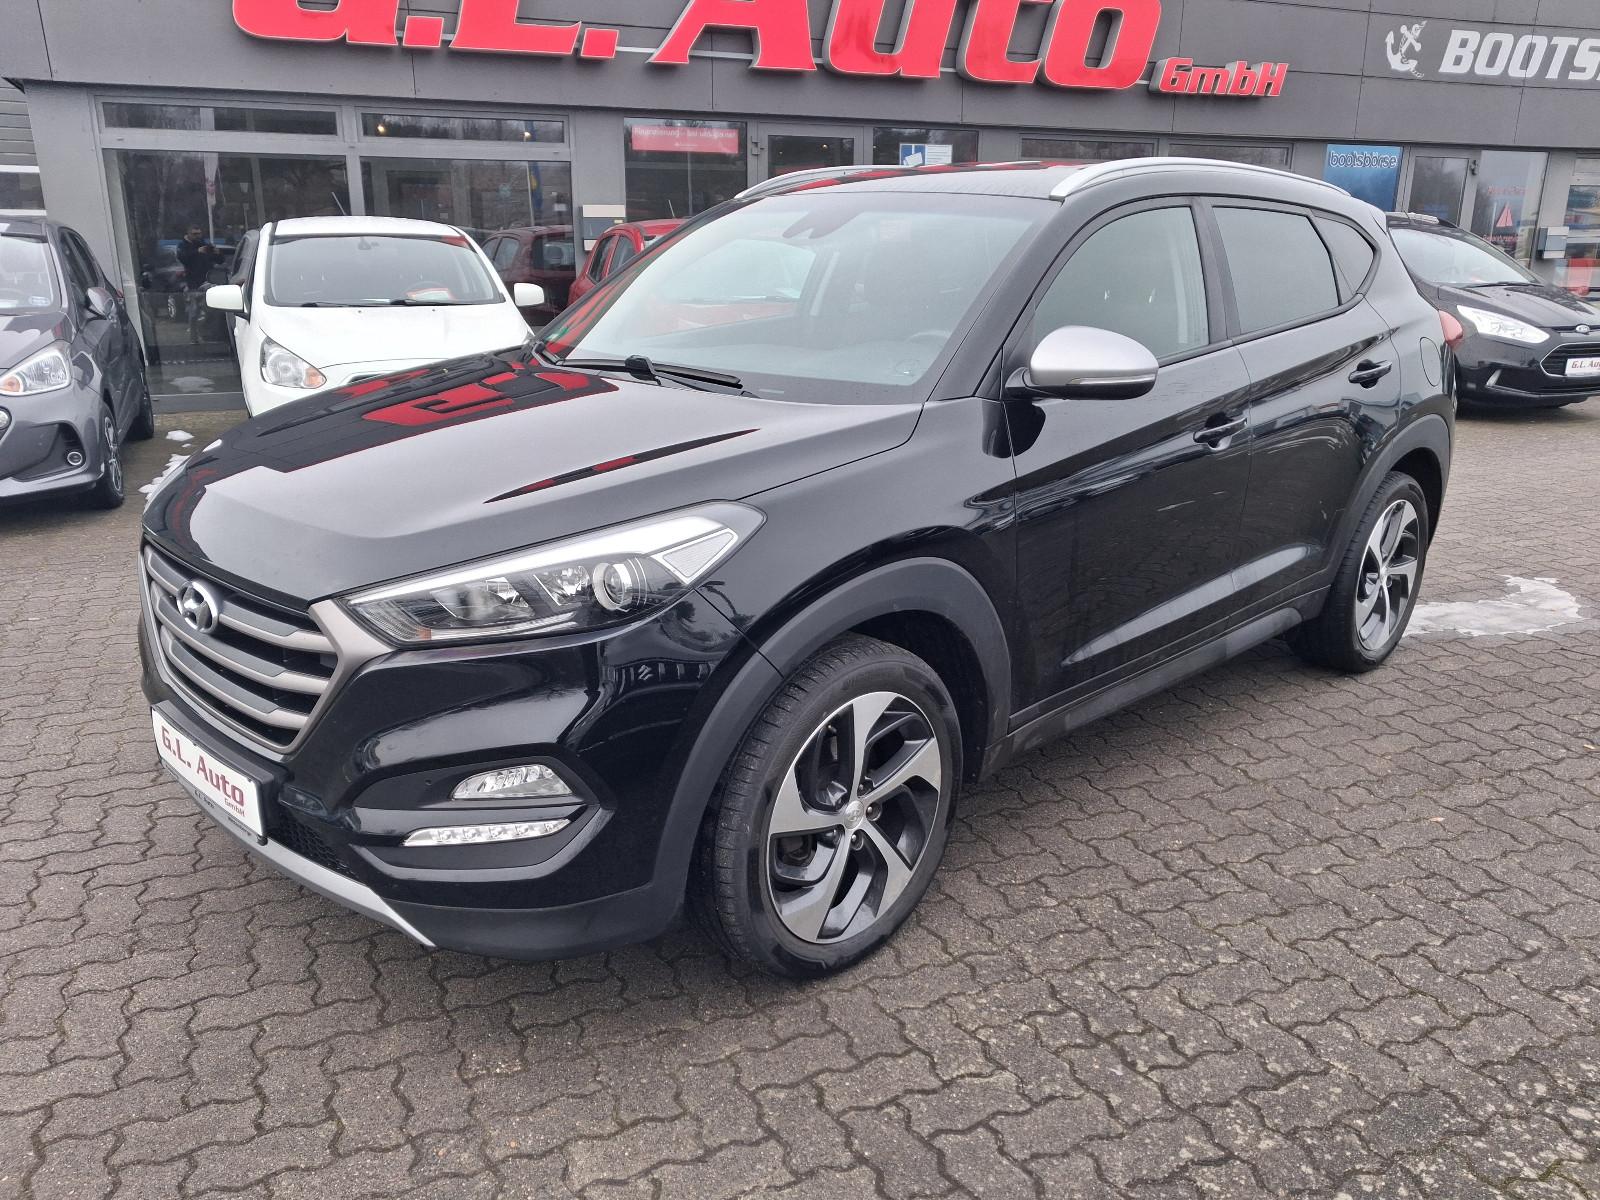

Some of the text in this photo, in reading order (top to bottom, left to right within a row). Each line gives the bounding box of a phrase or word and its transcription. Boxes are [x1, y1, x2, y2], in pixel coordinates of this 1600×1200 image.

[1438, 29, 1600, 81] BOOTS
[1158, 56, 1289, 97] GmbH
[1329, 150, 1398, 169] bootsbörse
[1586, 360, 1600, 368] Au
[161, 725, 192, 769] G.L.
[196, 754, 245, 807] Auto
[224, 798, 245, 818] GmbH
